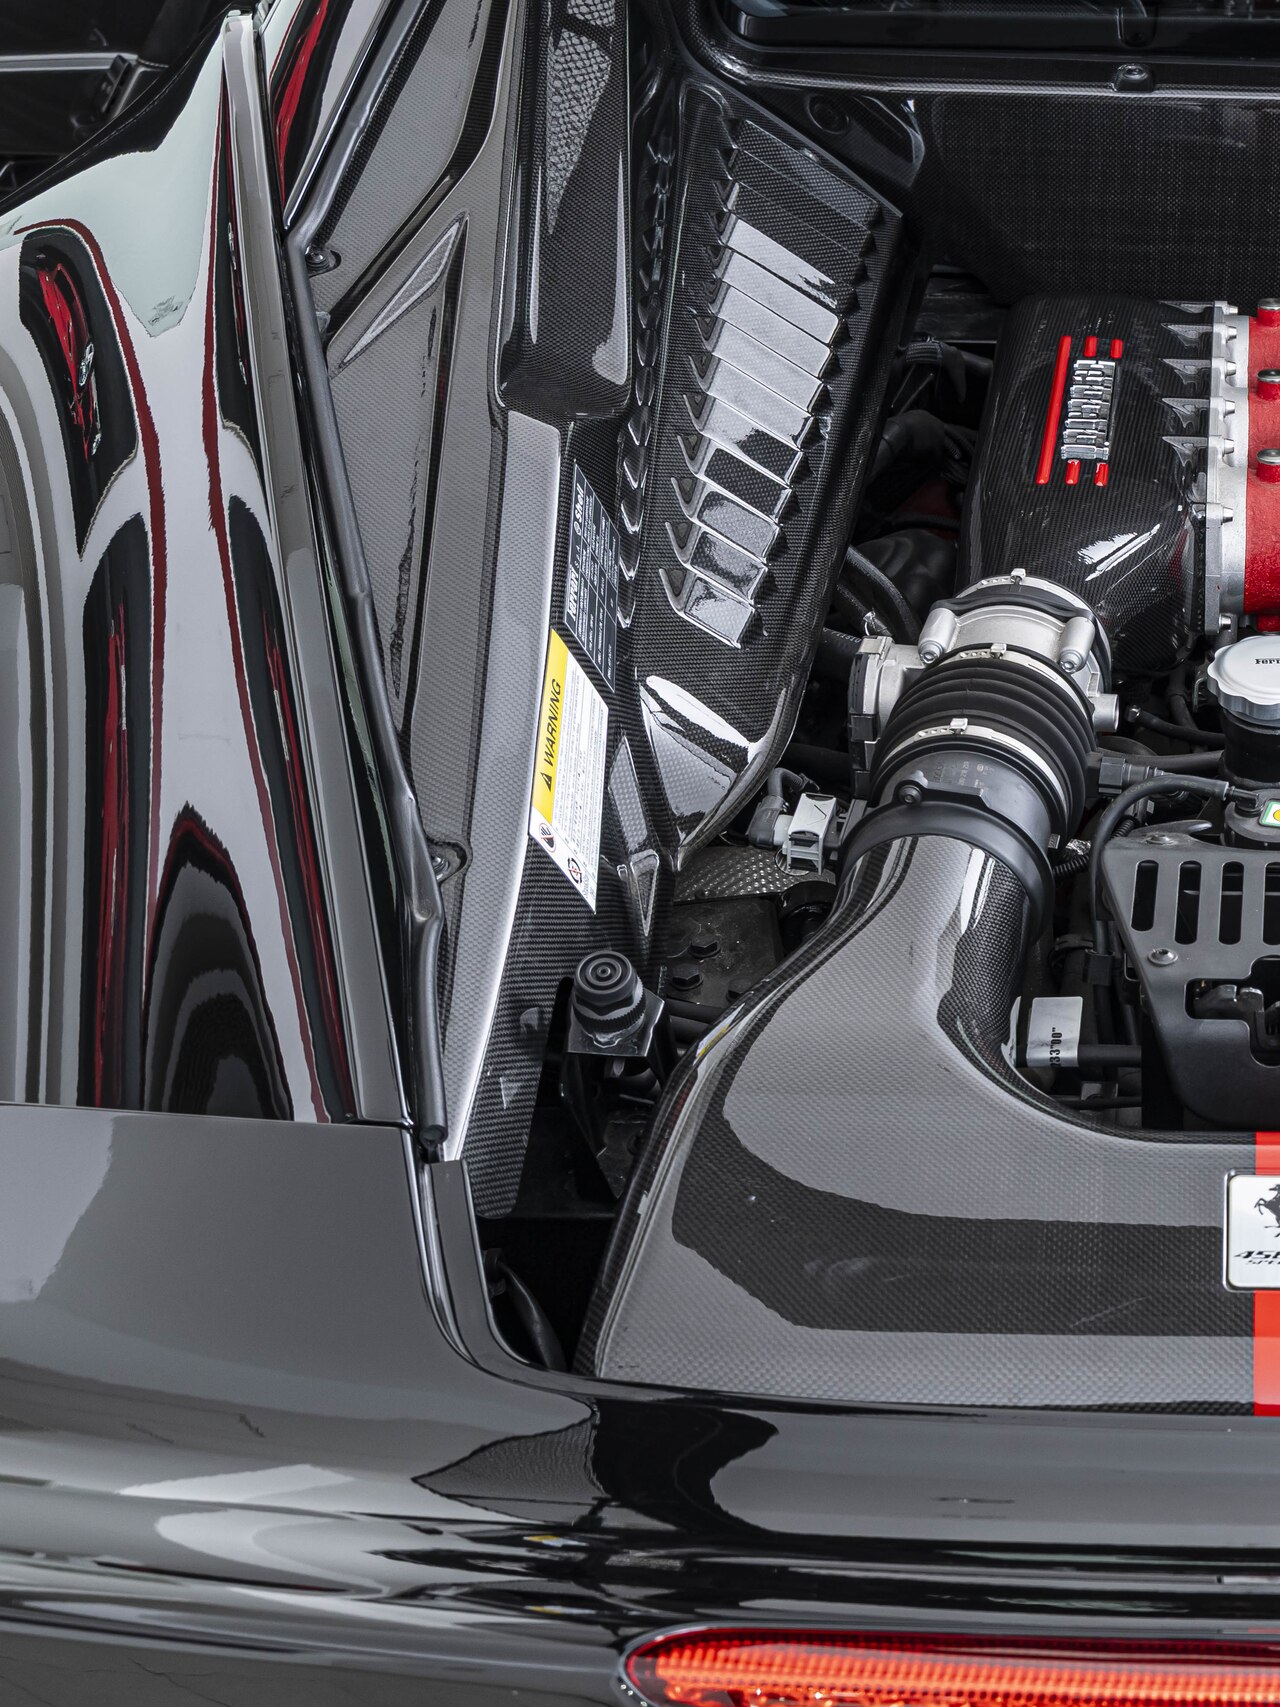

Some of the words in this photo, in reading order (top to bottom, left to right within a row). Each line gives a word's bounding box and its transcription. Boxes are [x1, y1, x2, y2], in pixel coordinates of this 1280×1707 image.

[567, 565, 579, 622] Ferrari
[574, 483, 585, 521] Shell
[543, 678, 561, 767] WARNING
